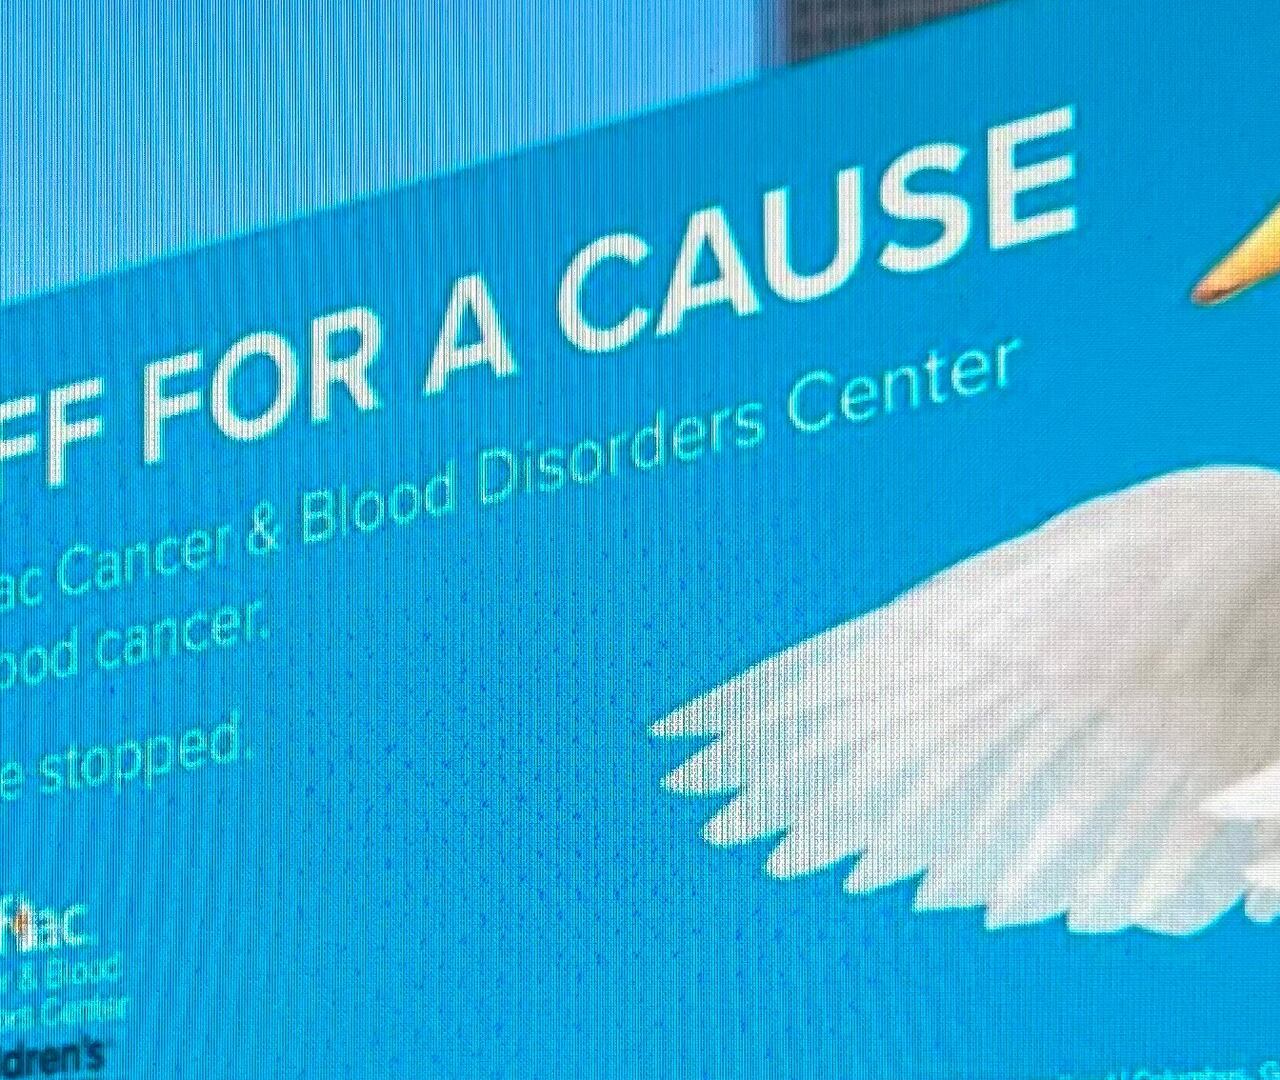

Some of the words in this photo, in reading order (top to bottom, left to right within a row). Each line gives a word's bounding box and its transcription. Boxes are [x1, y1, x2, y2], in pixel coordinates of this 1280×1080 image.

[142, 304, 383, 465] FOR
[423, 272, 519, 397] A
[557, 104, 1078, 354] CAUSE
[55, 520, 232, 598] Cancer
[247, 501, 282, 557] &
[301, 460, 456, 545] Blood
[478, 399, 766, 507] Disorders
[786, 337, 1020, 434] Center
[95, 596, 269, 670] cancer.
[38, 708, 253, 795] stopped.
[45, 951, 124, 989] Blood
